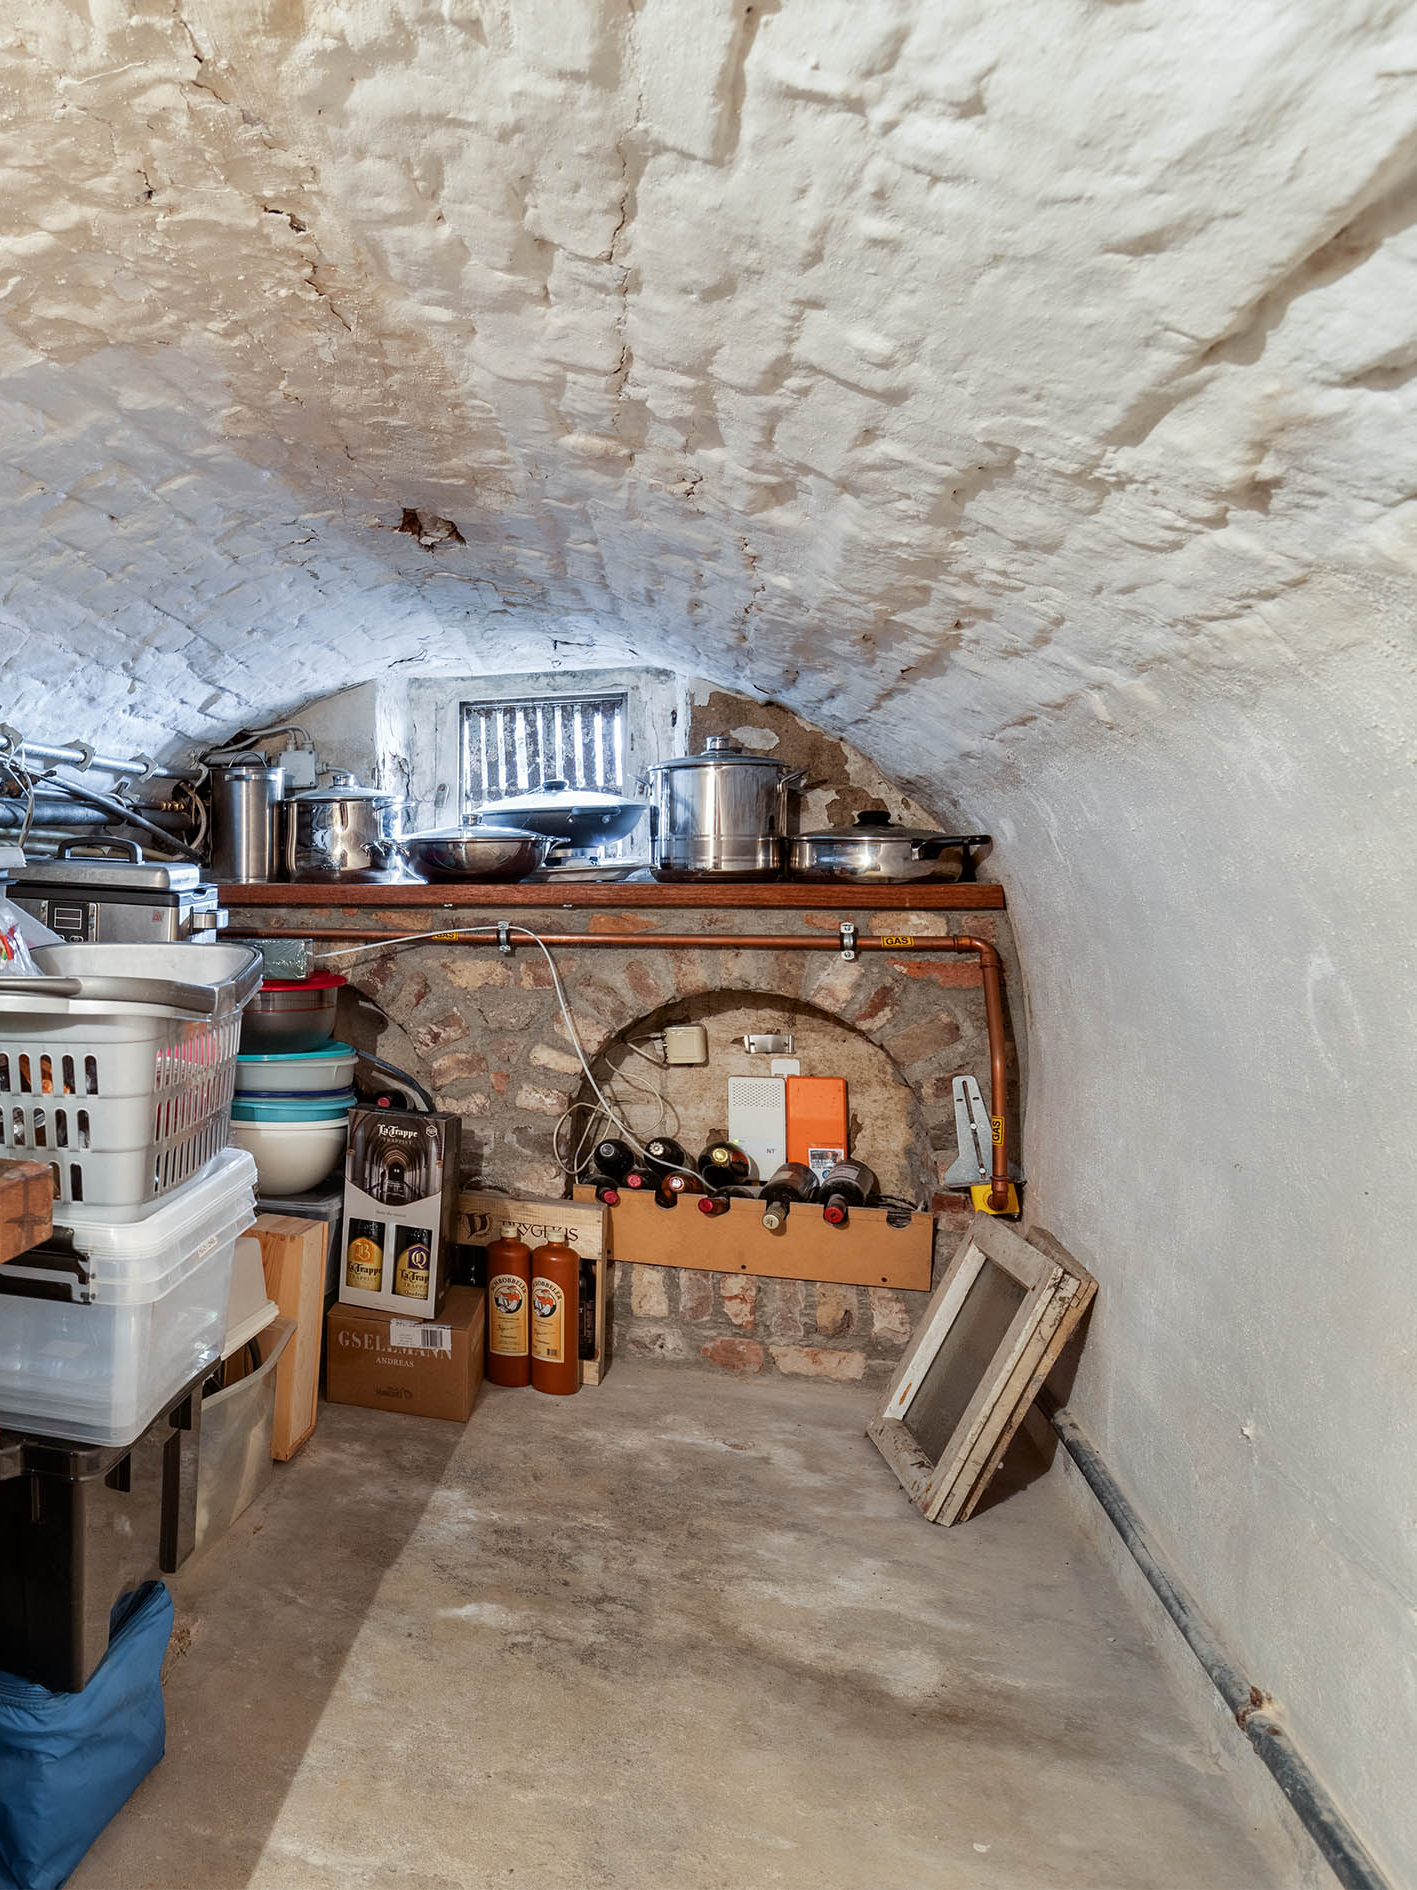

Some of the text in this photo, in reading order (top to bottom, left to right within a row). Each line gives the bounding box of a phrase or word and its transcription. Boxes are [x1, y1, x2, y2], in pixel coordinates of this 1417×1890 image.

[885, 936, 909, 945] GAS
[992, 1120, 1001, 1141] GAS
[357, 1242, 371, 1261] B
[411, 1250, 427, 1269] Q
[408, 1271, 429, 1285] Trap
[375, 1357, 415, 1368] ANDREAS
